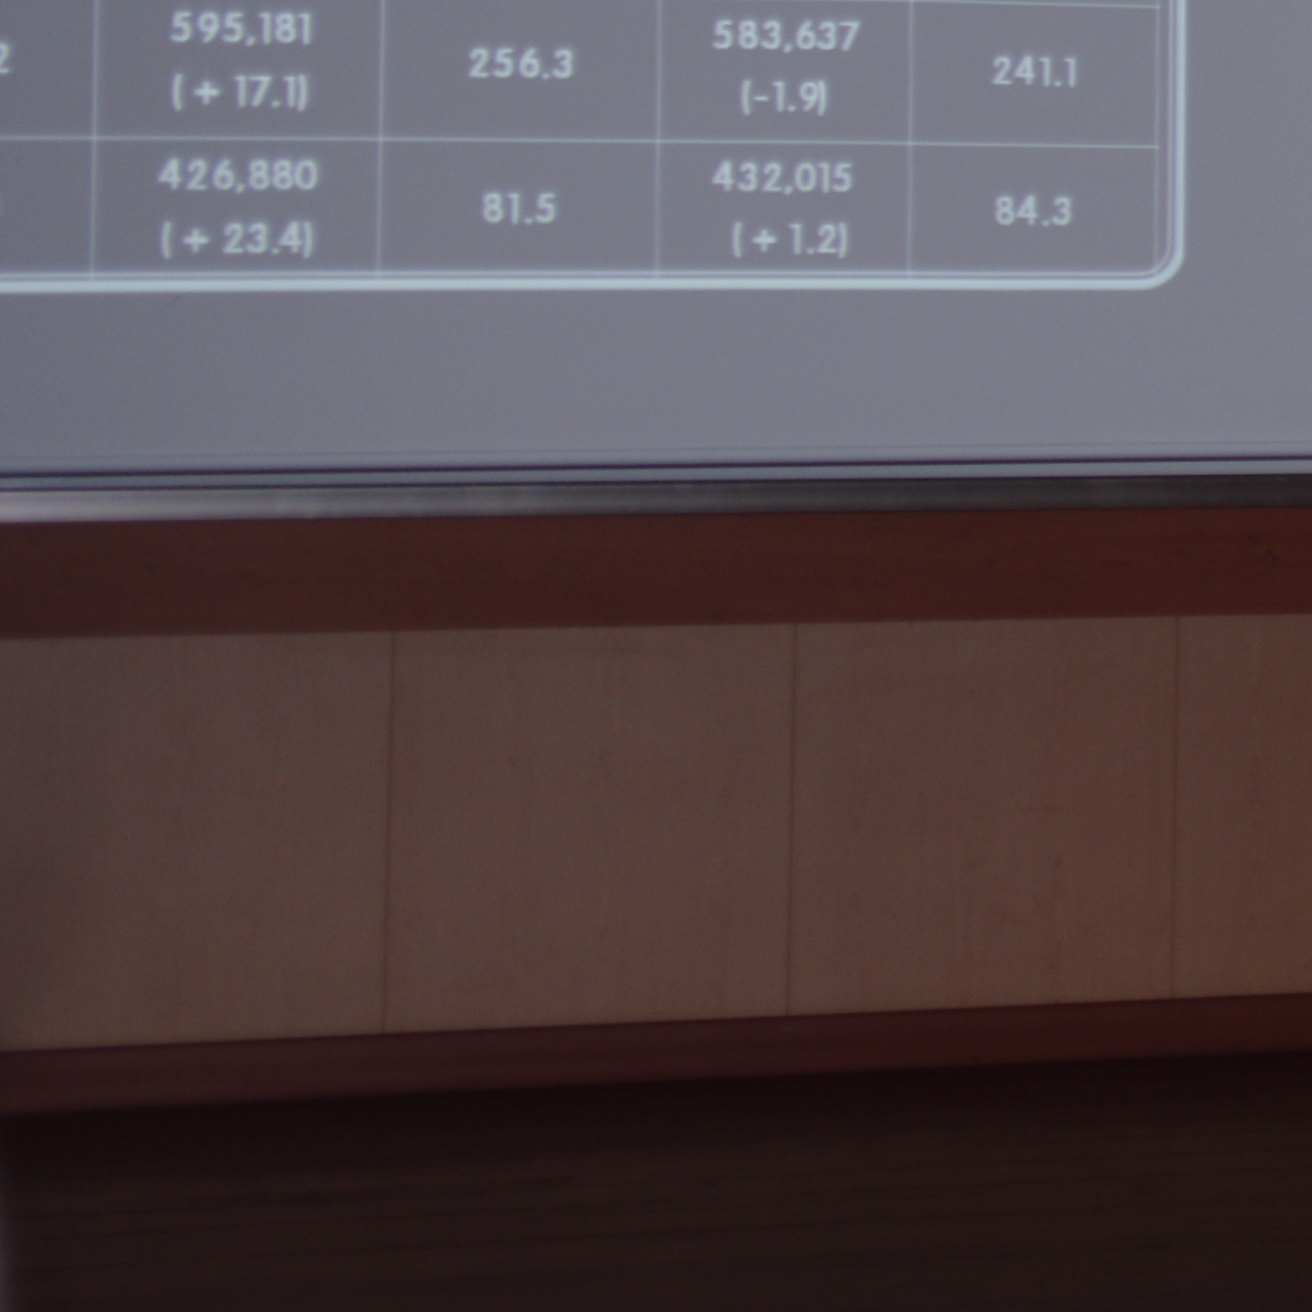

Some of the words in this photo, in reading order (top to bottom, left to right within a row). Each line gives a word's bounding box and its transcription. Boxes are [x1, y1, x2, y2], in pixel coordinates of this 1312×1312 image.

[171, 11, 311, 45] 595,181
[714, 19, 860, 52] 583,637
[469, 47, 573, 79] 256.3
[993, 55, 1076, 86] 241.1
[741, 80, 827, 115] (-1.9)
[159, 158, 318, 192] 426,880
[713, 160, 851, 194] 432,015
[483, 192, 555, 223] 81.5
[996, 195, 1071, 226] 84.3
